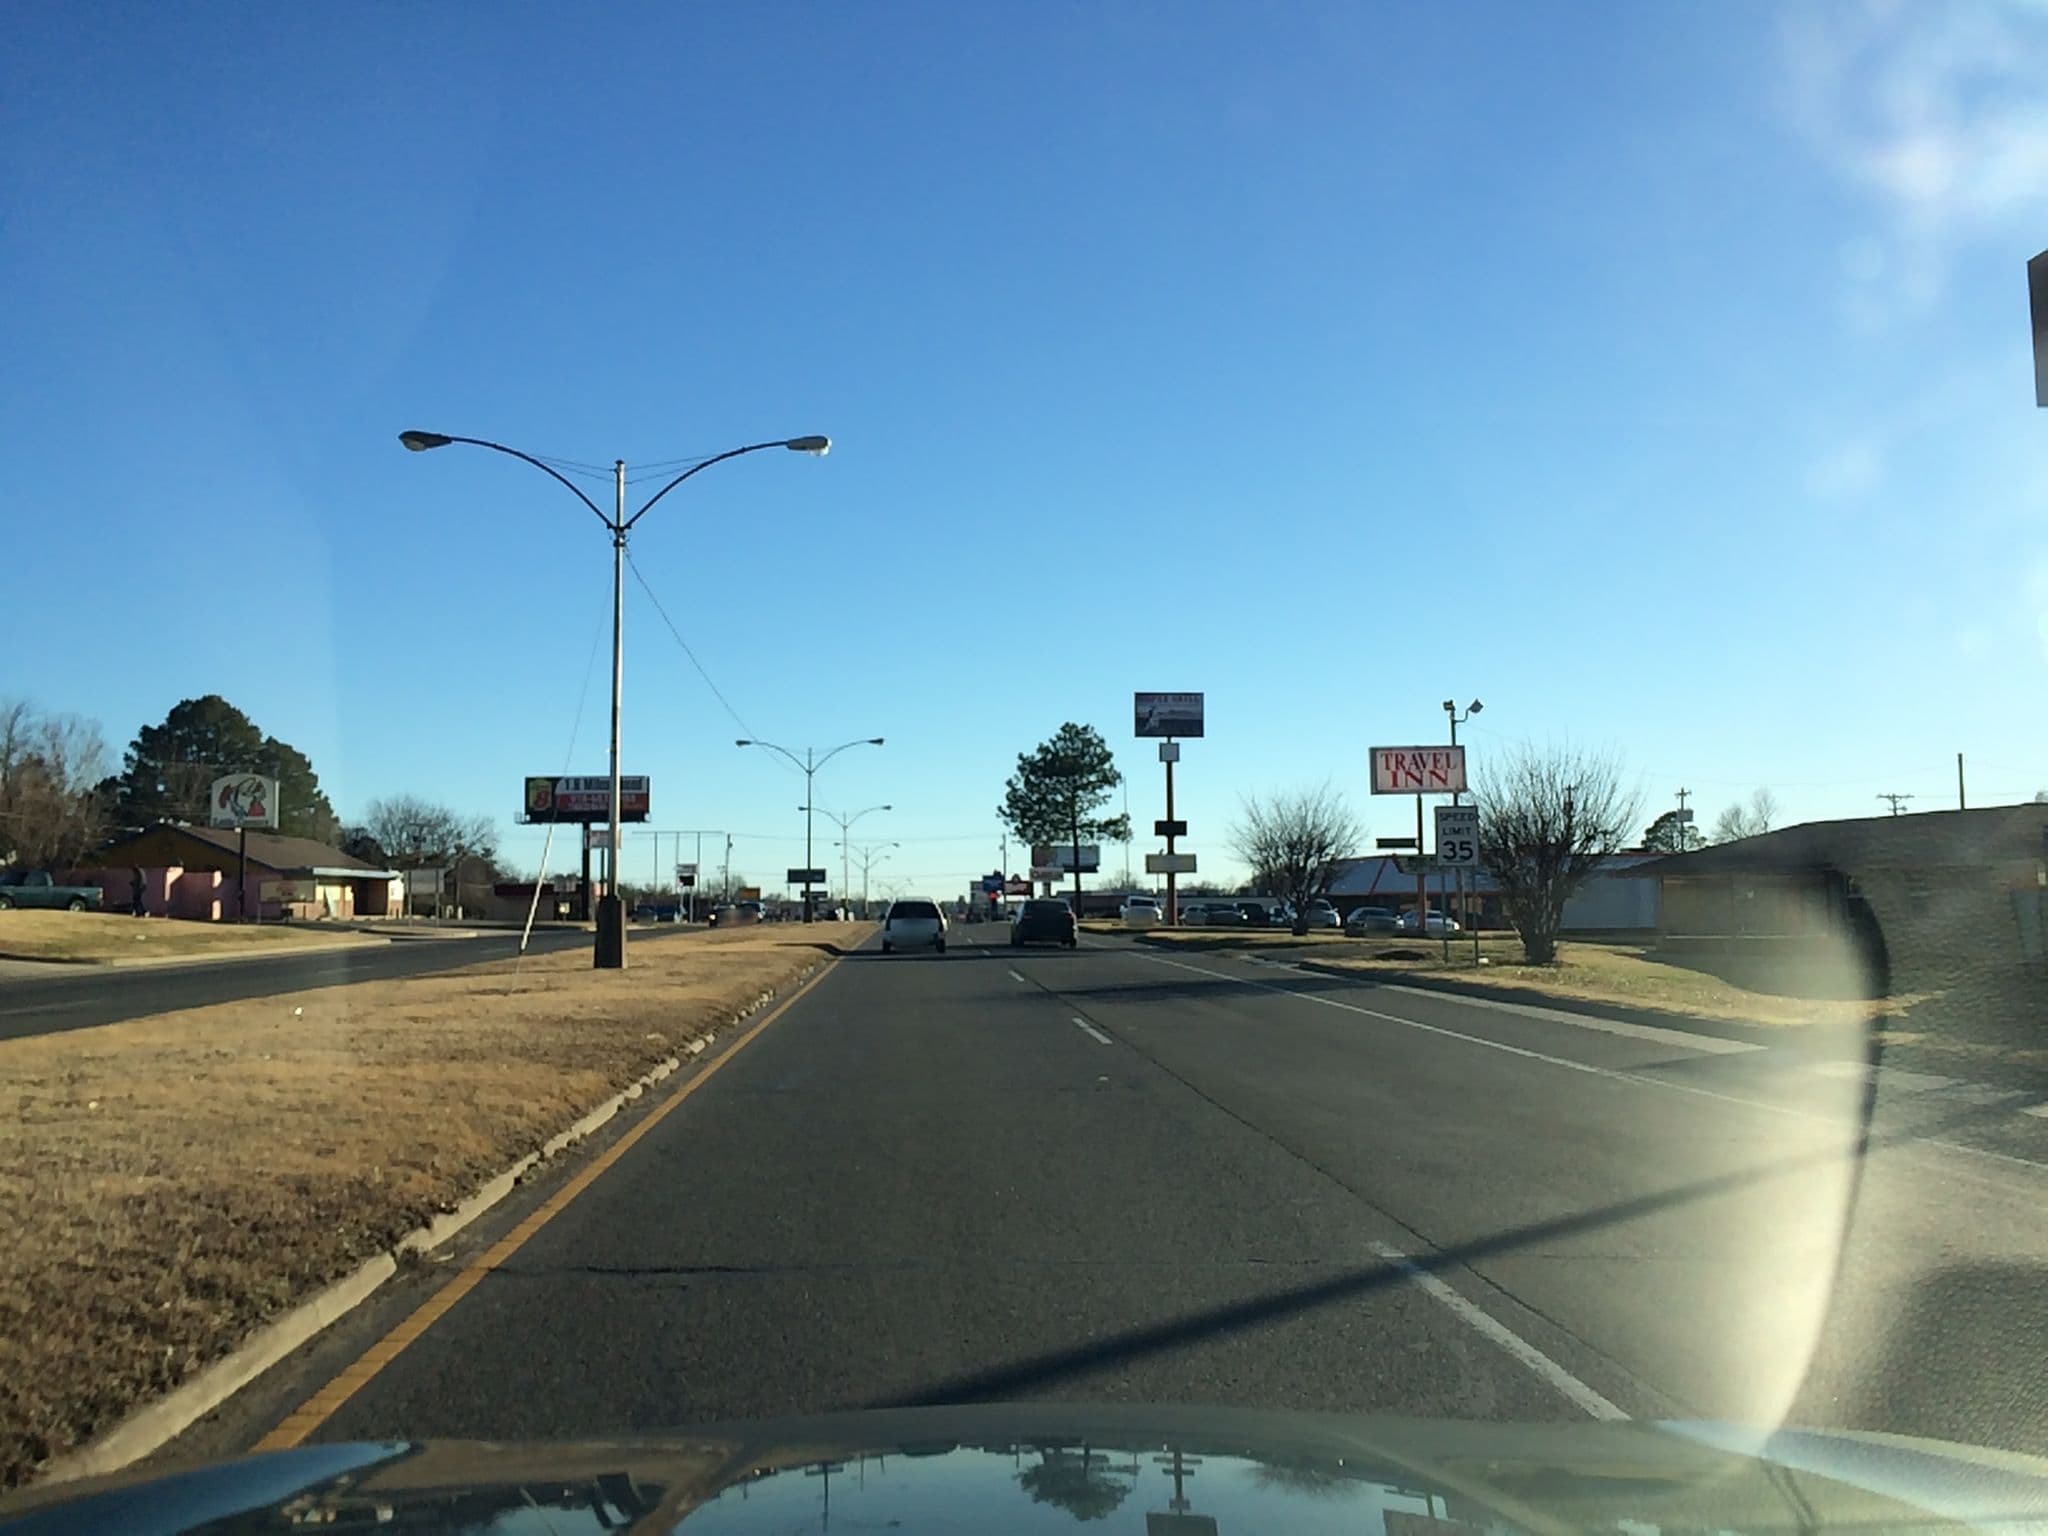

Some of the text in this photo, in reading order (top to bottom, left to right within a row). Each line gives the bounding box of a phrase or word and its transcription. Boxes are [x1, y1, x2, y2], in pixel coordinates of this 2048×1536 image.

[1381, 752, 1456, 771] TRAVEL
[1390, 771, 1450, 788] INN
[1440, 811, 1476, 822] SPEED
[1443, 827, 1471, 837] LIMIT
[1442, 840, 1474, 861] 35
